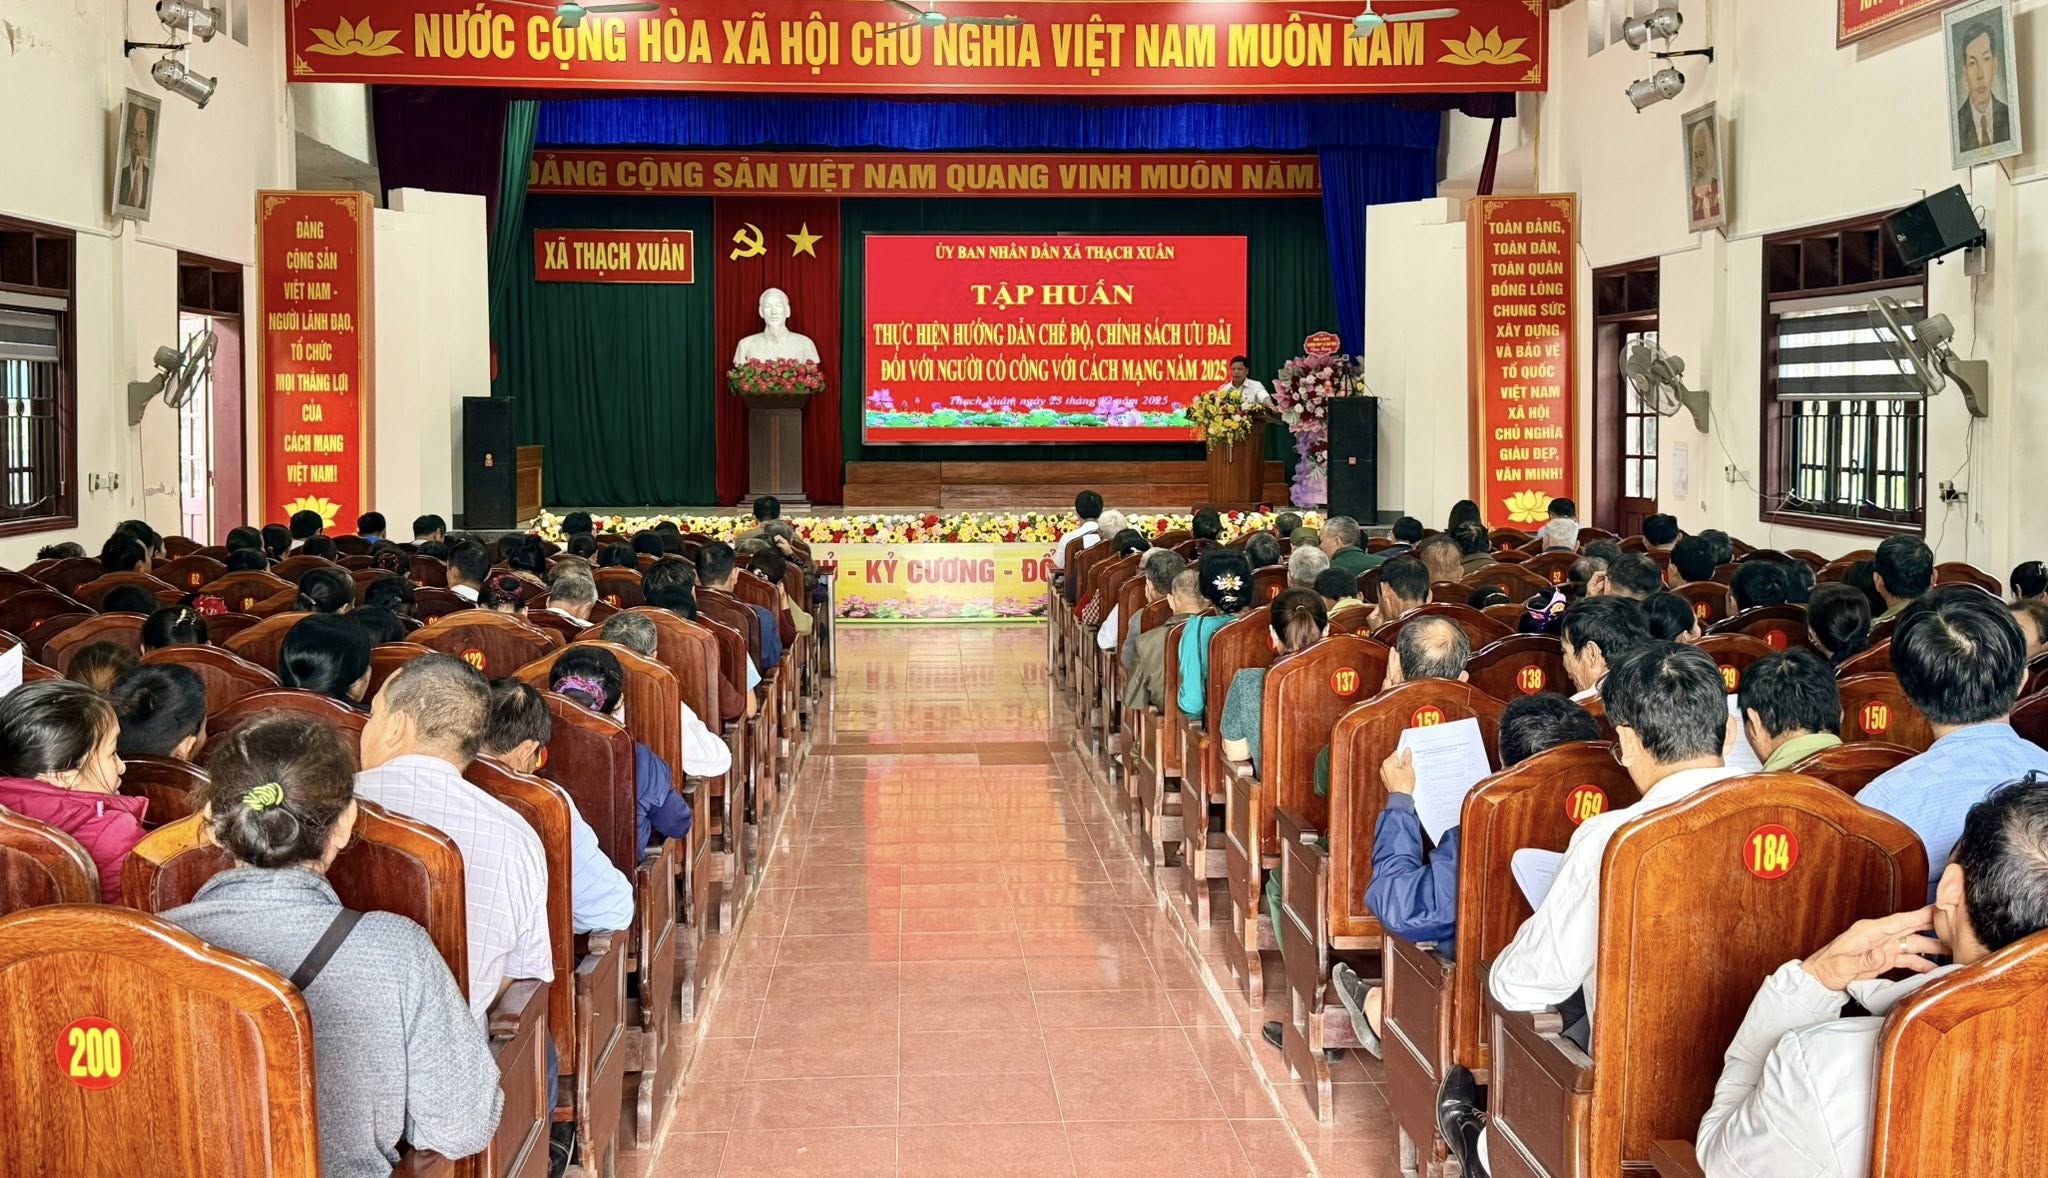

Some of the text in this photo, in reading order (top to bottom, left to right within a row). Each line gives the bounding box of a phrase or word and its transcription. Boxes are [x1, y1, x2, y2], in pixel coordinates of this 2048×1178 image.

[415, 3, 515, 60] NƯỚC
[638, 7, 713, 64] HÒA
[721, 11, 771, 65] XÃ
[780, 11, 839, 75] HỘI
[933, 14, 1041, 68] NGHĨA
[1051, 13, 1126, 77] VIỆT
[1135, 23, 1216, 68] NAM
[1227, 12, 1332, 68] MUÔN
[616, 156, 704, 192] CỘNG
[713, 156, 778, 189] SẢN
[788, 158, 855, 193] VIỆT
[864, 163, 937, 190] NAM
[946, 163, 1049, 192] QUANG
[1058, 164, 1132, 190] VINH
[1140, 159, 1233, 190] MUÔN
[296, 214, 324, 239] ĐẢNG
[1488, 217, 1566, 235] TOÀN ĐẢNG,
[544, 235, 685, 277] XÃ THẠCH XUÂN
[935, 241, 1175, 262] ỦY BAN NHÂN DÂN XÃ THẠCH XUÂN
[1493, 239, 1561, 255] TOÀN DÂN,
[286, 246, 338, 274] CỘNG SẢN
[1491, 259, 1563, 276] TOÀN QUÂN
[284, 278, 305, 304] VIỆT
[307, 282, 331, 300] NAM
[970, 278, 1135, 311] TẬP HUẤN
[1530, 280, 1563, 296] LÒNG
[268, 308, 354, 335] NGƯỜI LÃNH ĐẠO,
[1493, 301, 1566, 317] CHUNG SỨC
[872, 317, 1232, 352] THỰC HIỆN HƯỚNG DẪN CHẾ ĐỘ, CHÍNH SÁCH ƯU ĐÃI
[1496, 322, 1560, 340] XÂY DỰNG
[290, 336, 333, 361] TỔ CHỨC
[1495, 341, 1561, 359] VÀ BẢO VỆ
[275, 366, 349, 396] MỌI THẮNG LỢI
[880, 351, 1228, 387] ĐỐI VỚI NGƯỜI CÓ CÔNG VỚI CÁCH MẠNG NĂM 2025
[1502, 361, 1555, 380] TỔ QUỐC
[1065, 395, 1097, 408] tháng
[1500, 384, 1561, 402] VIỆT NAM
[302, 397, 323, 422] CỦA
[1507, 404, 1550, 421] XÃ HỘI
[284, 430, 344, 456] CÁCH MẠNG
[1495, 423, 1564, 440] CHỦ NGHĨA
[1500, 445, 1559, 462] GIÀU ĐẸP,
[287, 460, 338, 486] VIỆT NAM!
[1495, 466, 1564, 482] VĂN MINH!
[866, 551, 898, 584] KỶ
[907, 556, 995, 584] CƯƠNG
[1335, 671, 1355, 691] 137
[1522, 669, 1541, 689] 138
[1864, 705, 1887, 730] 150
[1573, 790, 1603, 820] 169
[1752, 833, 1789, 872] 184
[68, 1027, 122, 1078] 200
